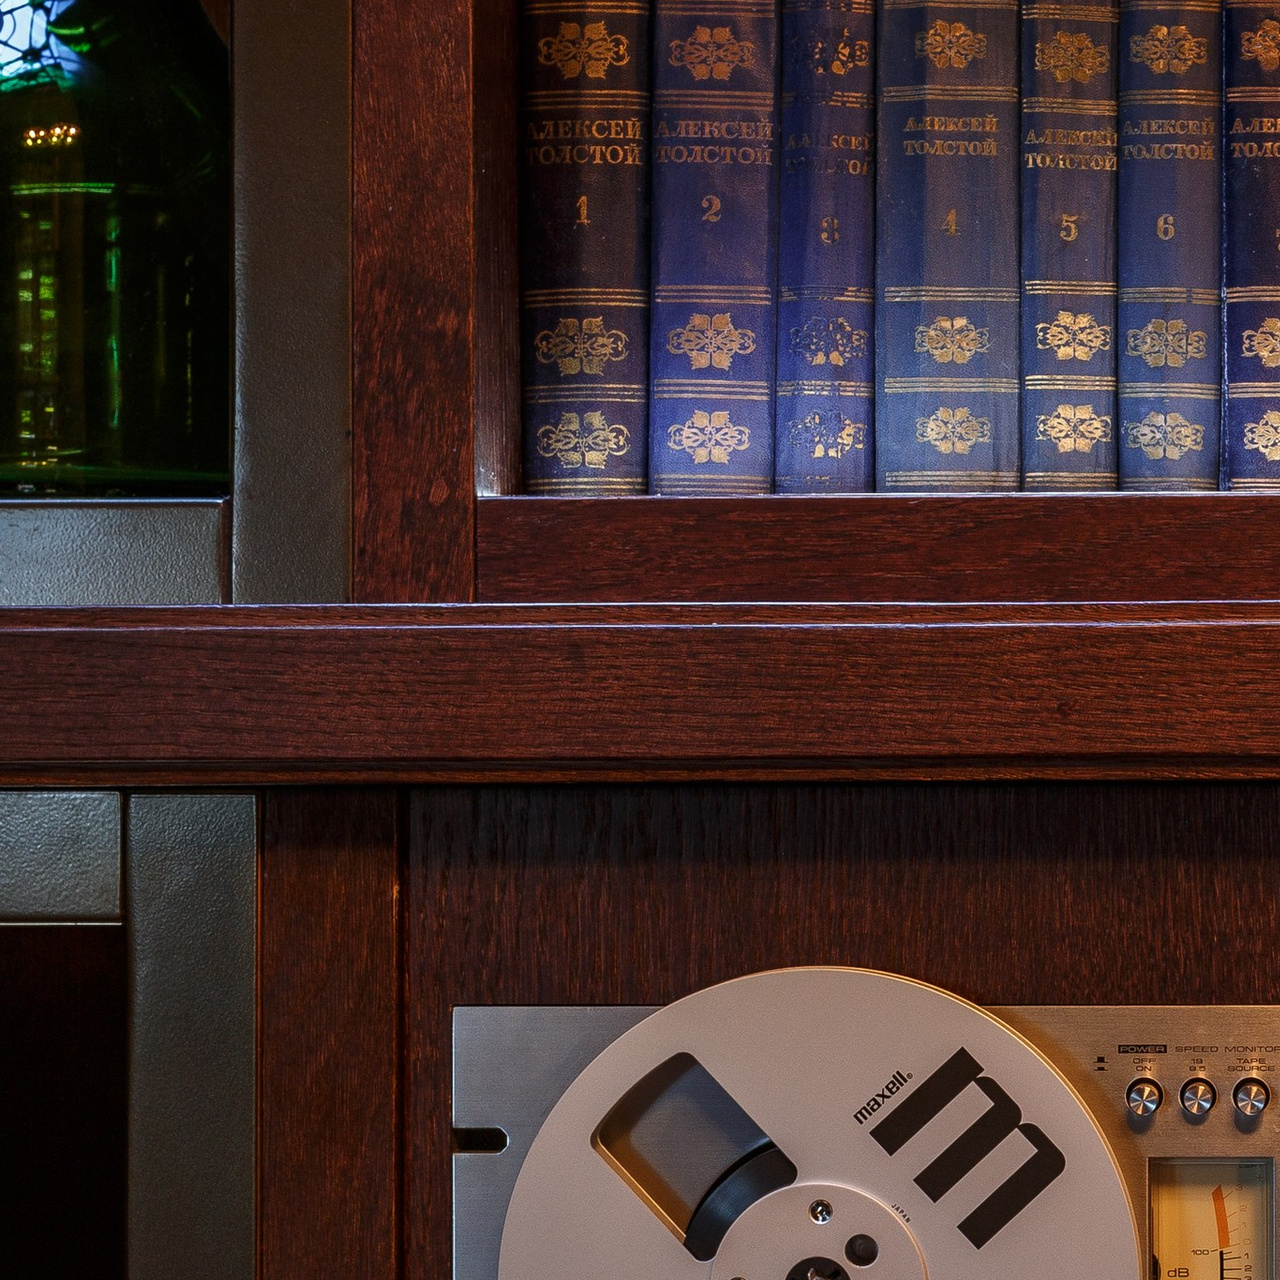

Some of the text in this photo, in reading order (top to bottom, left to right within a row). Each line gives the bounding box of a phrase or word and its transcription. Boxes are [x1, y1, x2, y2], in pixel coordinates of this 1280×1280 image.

[527, 118, 643, 140] АЛЕКСЕЙ
[654, 118, 774, 140] АЛЕКСЕЙ
[903, 113, 999, 133] АЛЕКСЕЙ
[1122, 116, 1215, 135] АЛЕКСЕЙ
[903, 137, 999, 156] ТОЛСТОЙ
[1024, 126, 1118, 147] АЛЕКСЕЙ
[527, 143, 643, 166] ТОЛСТОЙ
[656, 143, 773, 166] ТОЛСТОЙ
[1024, 150, 1117, 170] ТОЛСТОЙ
[1122, 141, 1215, 161] ТОЛСТОЙ
[576, 195, 590, 225] 1
[701, 194, 722, 223] 2
[820, 216, 839, 245] 3
[941, 208, 961, 237] 4
[1060, 213, 1079, 242] 5
[1157, 213, 1175, 240] 6
[1119, 1045, 1166, 1053] POWER
[1175, 1045, 1219, 1053] SPEED
[853, 1070, 908, 1124] maxell
[891, 1203, 911, 1223] JAPAN
[1167, 1268, 1190, 1278] dB
